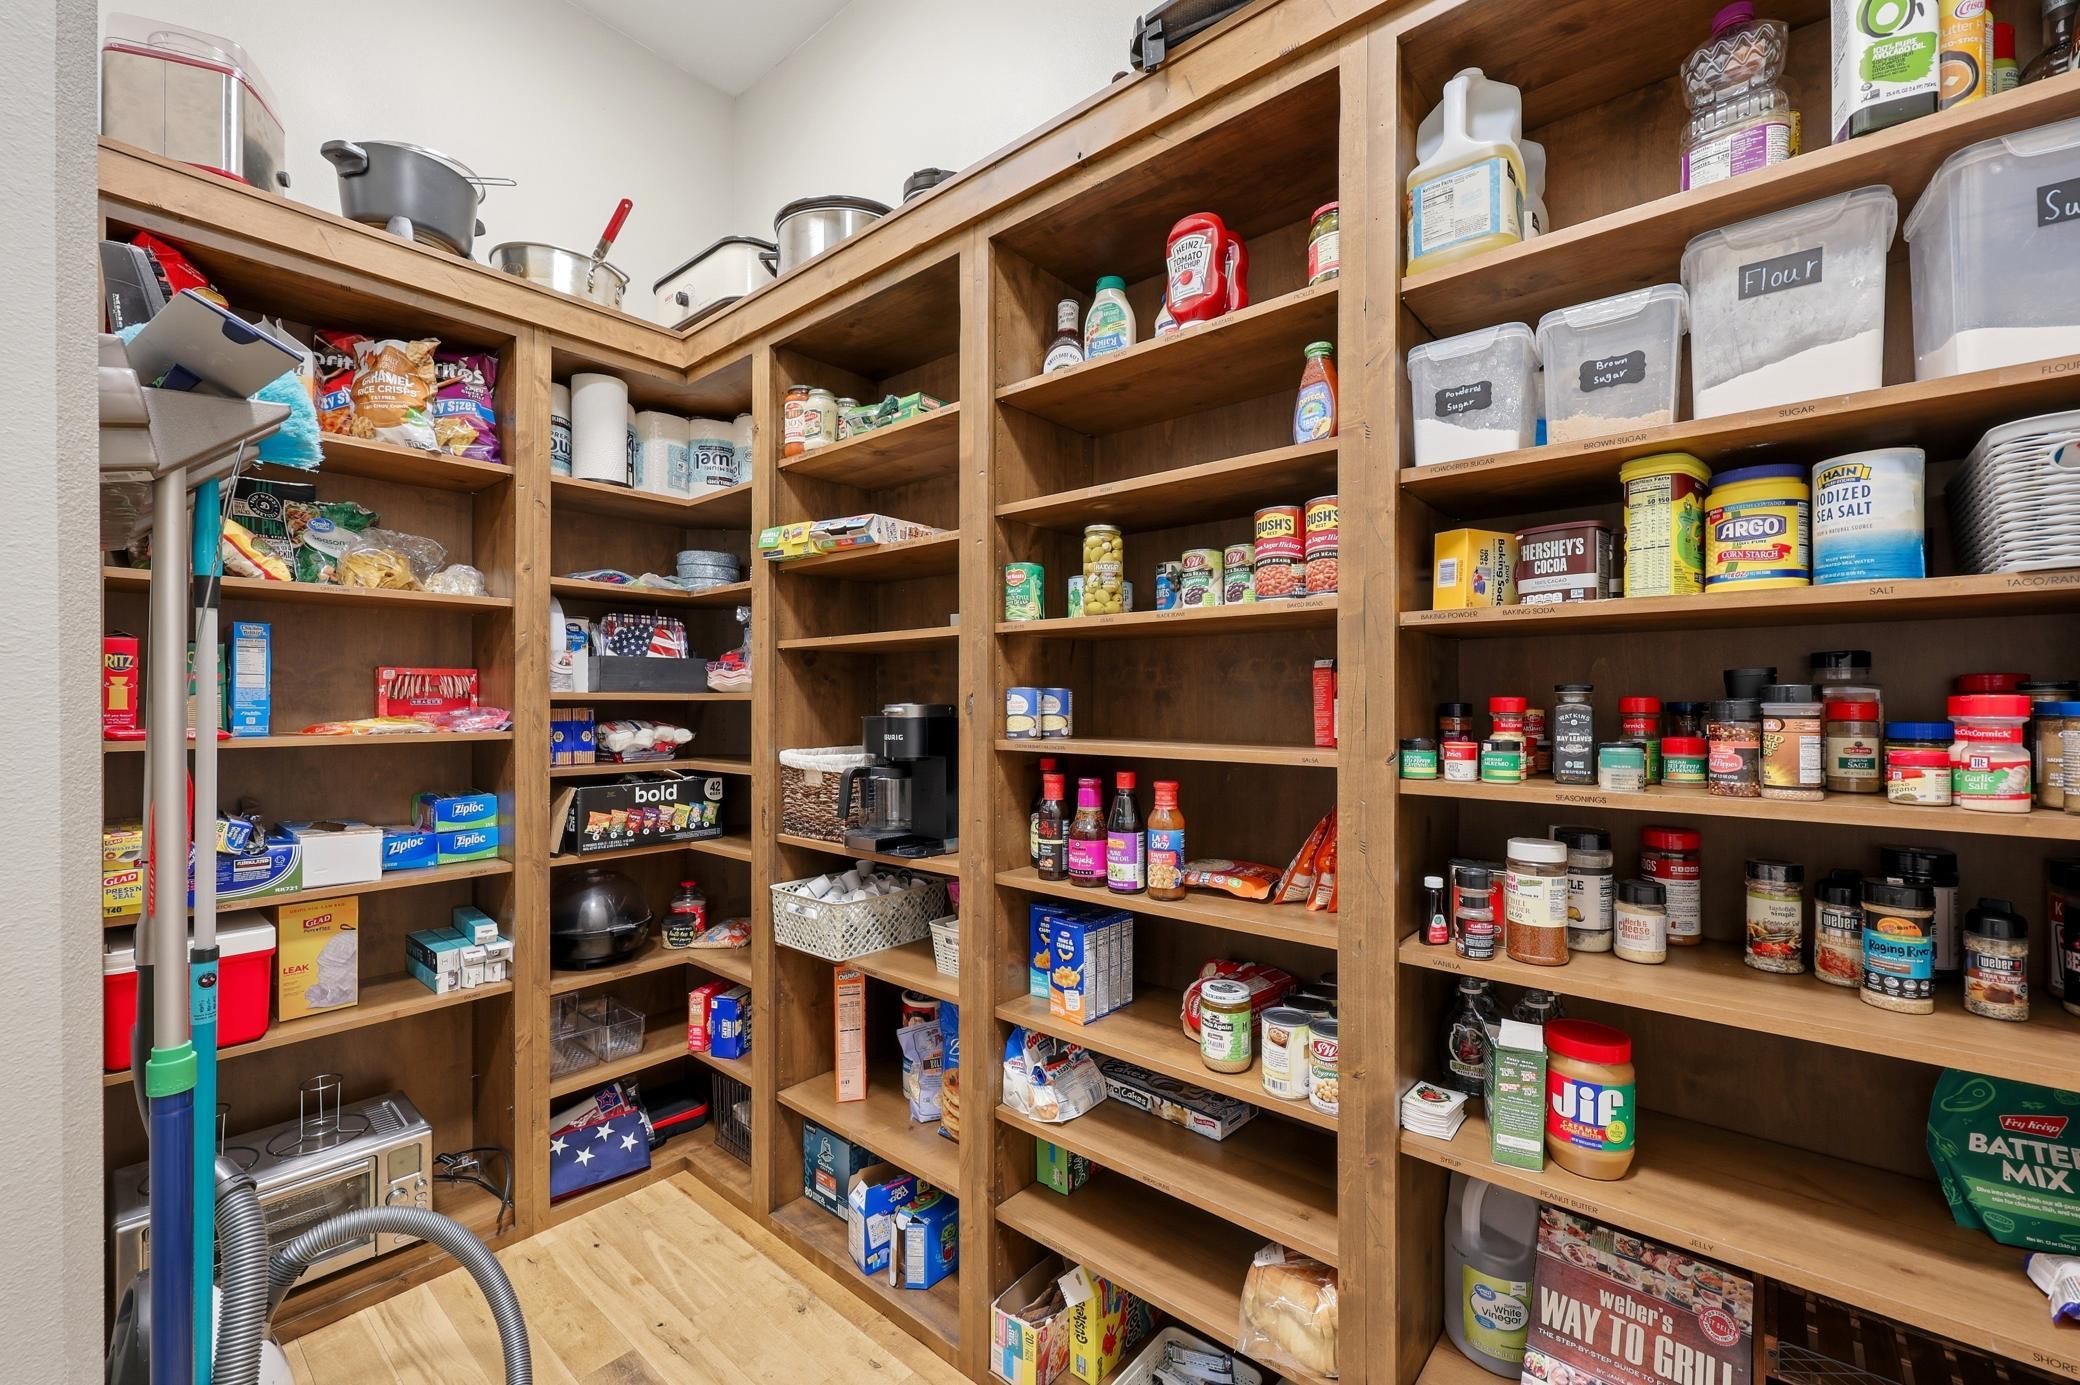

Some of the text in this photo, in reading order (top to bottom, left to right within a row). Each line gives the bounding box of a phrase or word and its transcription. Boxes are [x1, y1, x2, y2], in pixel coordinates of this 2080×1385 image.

[1176, 241, 1199, 255] HEINZ
[1173, 251, 1202, 266] TOMATO
[1174, 260, 1201, 273] KETCHUP
[1744, 258, 1818, 293] Flour
[1596, 356, 1628, 370] Brown
[357, 385, 418, 397] RICE CRISPS
[1779, 405, 1815, 417] SUGAR
[1583, 433, 1648, 450] BROWN SUGAR
[1430, 458, 1495, 473] POWDERED SUGAR
[1823, 466, 1857, 481] HAIN
[1816, 485, 1871, 507] IODIZED
[1817, 501, 1872, 523] SEA SALT
[1257, 518, 1292, 535] BUSH'S
[1721, 518, 1779, 539] ARGO
[1521, 537, 1585, 562] HERSHEY'S
[1722, 550, 1778, 559] CORN STARCH
[1496, 539, 1506, 578] Baking
[1534, 557, 1567, 575] COCOA
[2007, 574, 2080, 587] TACO/RAN
[1869, 586, 1894, 596] SALT
[1421, 610, 1478, 620] BAKING POWDER
[1502, 606, 1555, 616] BAKING SODA
[104, 653, 134, 668] RITZ
[1558, 713, 1590, 722] WATKINS
[1302, 756, 1319, 764] SALSA
[1964, 774, 1995, 783] Garlic
[710, 780, 721, 792] 42
[1967, 782, 1988, 790] Salt
[635, 784, 678, 804] bold
[1555, 794, 1607, 804] SEASONINGS
[455, 801, 484, 816] Ziploc
[456, 832, 486, 848] Ziploc
[1151, 834, 1160, 842] LA
[388, 836, 424, 855] Ziploc
[104, 873, 137, 886] GLAD
[105, 886, 142, 895] PRESS'N
[112, 892, 136, 900] SEAL
[305, 914, 331, 927] GLAD
[1824, 914, 1857, 929] weber
[1618, 921, 1649, 935] Cheese
[1869, 939, 1905, 957] Raging
[283, 964, 309, 975] LEAK
[1433, 960, 1461, 970] VANILLA
[1980, 957, 2013, 970] weber
[1213, 1021, 1232, 1031] Again
[1121, 1087, 1147, 1105] Cakes
[1552, 1082, 1623, 1127] Jif
[1562, 1120, 1598, 1134] CREAMY
[2005, 1118, 2060, 1133] Fry Krisp
[1440, 1155, 1462, 1168] SYRUP
[2002, 1160, 2075, 1194] MIX
[1540, 1189, 1598, 1215] PEANUT BUTTER
[1689, 1239, 1715, 1252] JELLY
[1482, 1307, 1521, 1324] Vinegar
[1494, 1305, 1522, 1318] White
[1600, 1289, 1673, 1335] weber's
[1541, 1287, 1601, 1345] WAY
[1609, 1315, 1645, 1366] TO
[1654, 1335, 1733, 1385] GRILL
[1538, 1327, 1655, 1382] THE STEP-BY-STEP GUIDE TO
[2033, 1352, 2079, 1374] SHORE
